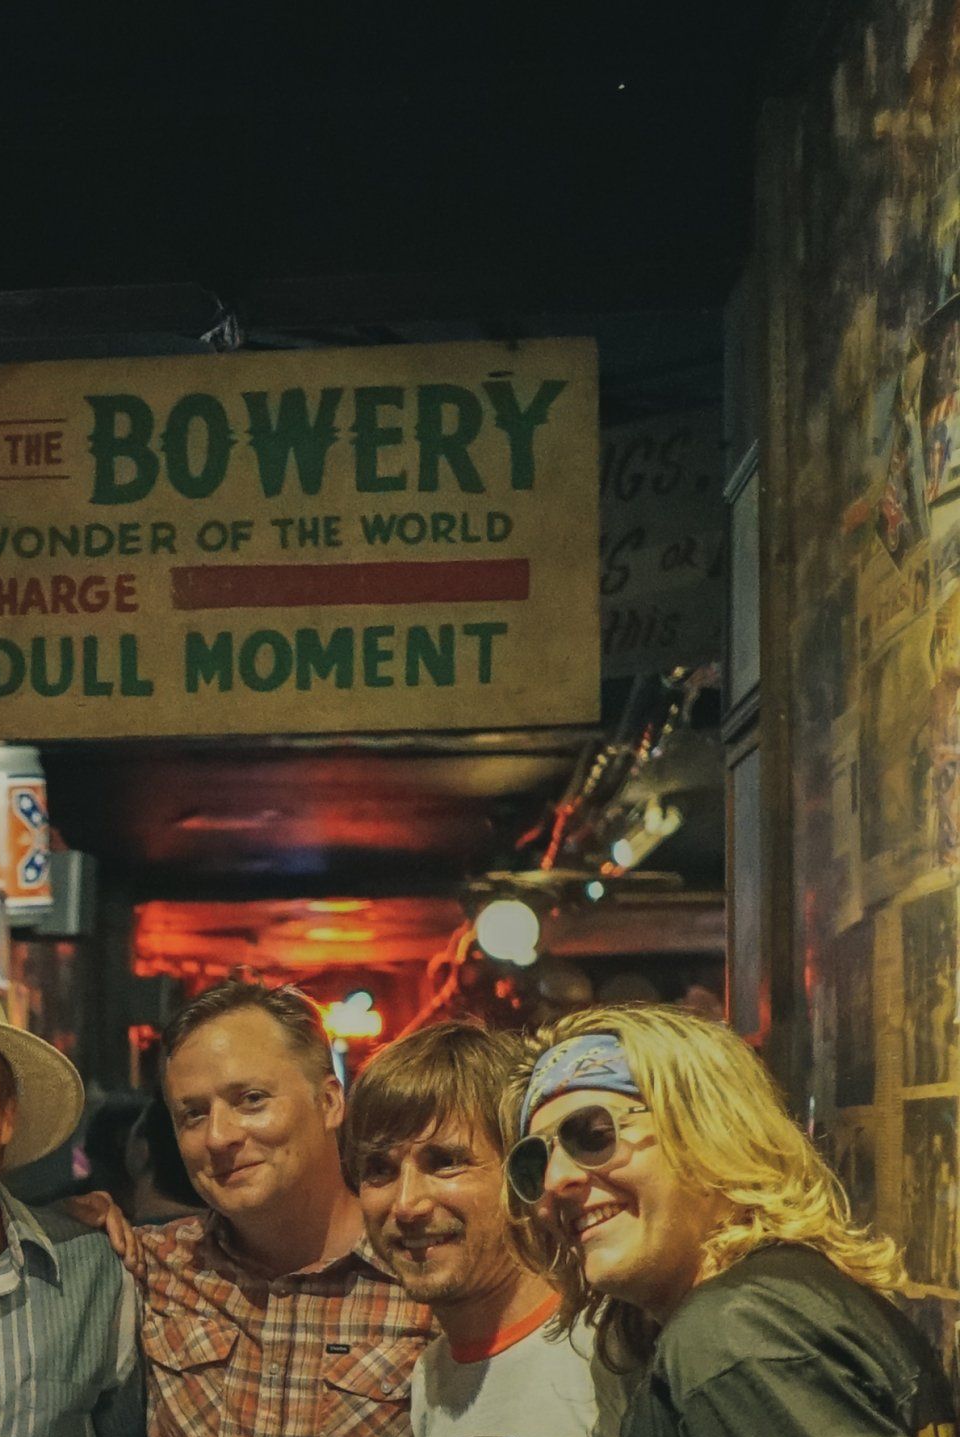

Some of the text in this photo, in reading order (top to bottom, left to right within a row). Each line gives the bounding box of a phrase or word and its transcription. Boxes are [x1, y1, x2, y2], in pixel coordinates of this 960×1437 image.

[6, 431, 64, 467] THE
[85, 378, 570, 505] BOWERY
[196, 520, 255, 553] OF
[271, 516, 342, 550] THE
[361, 511, 514, 547] WORLD
[184, 621, 508, 694] MOMENT
